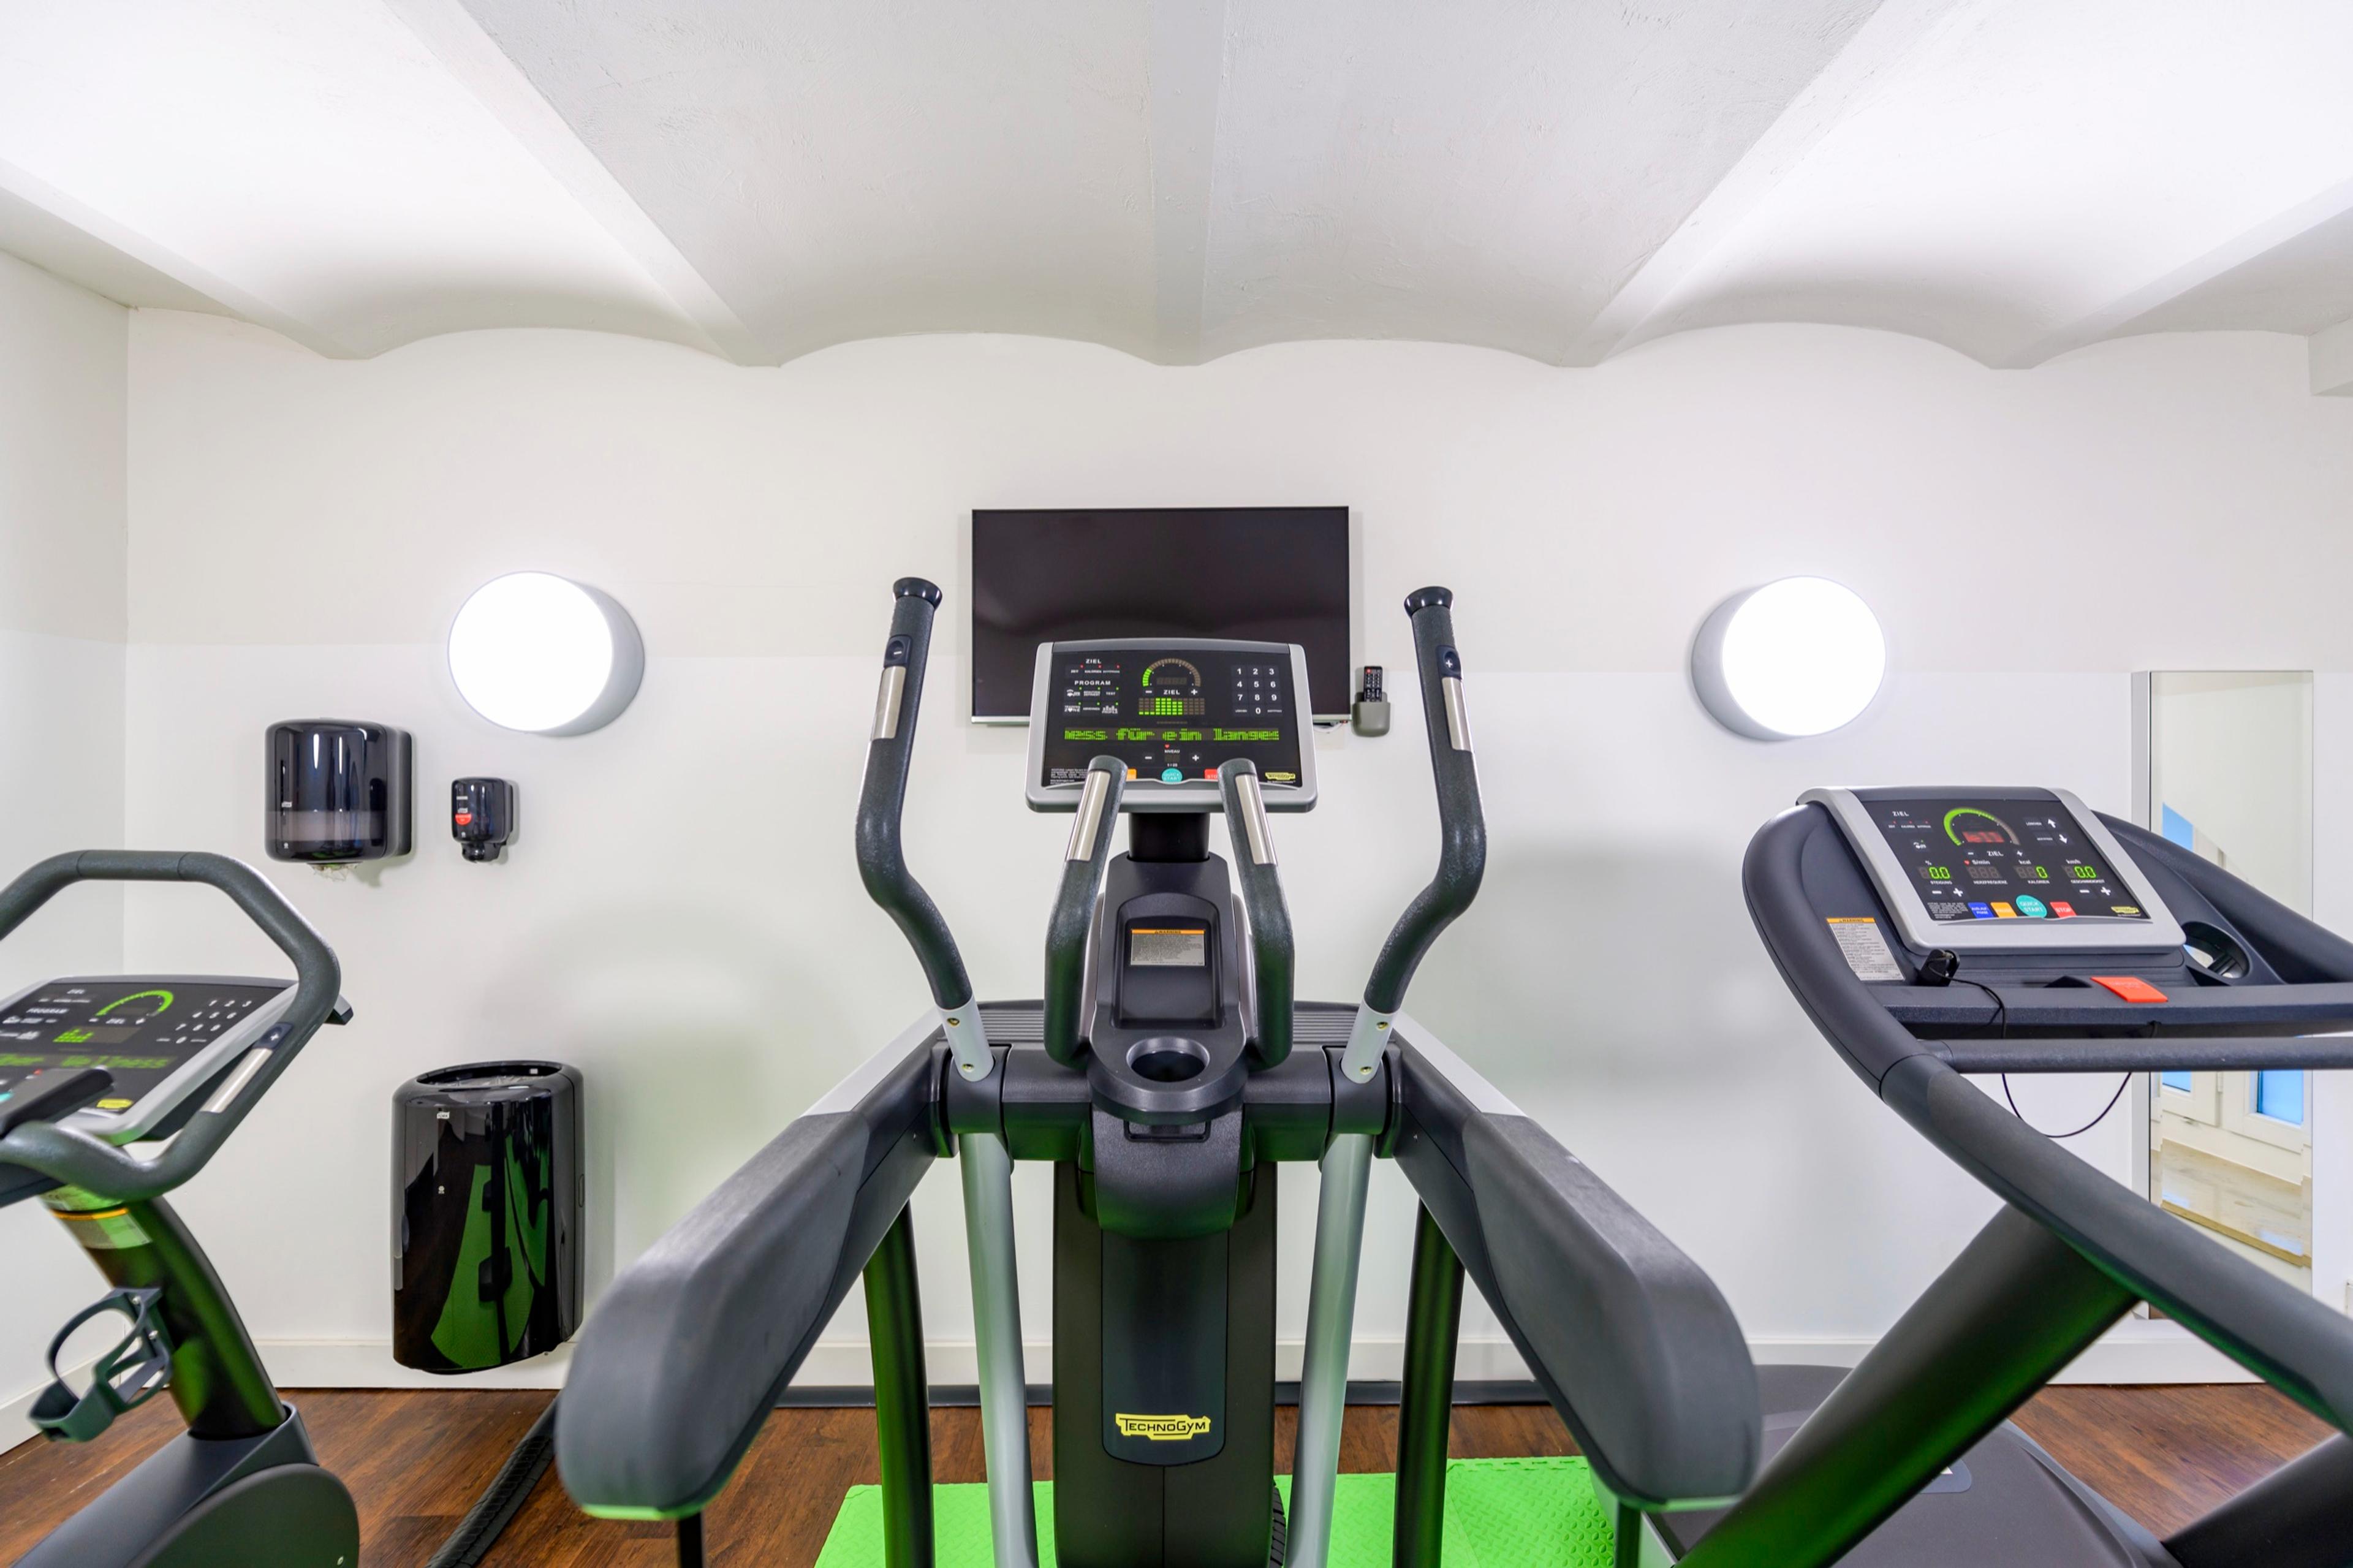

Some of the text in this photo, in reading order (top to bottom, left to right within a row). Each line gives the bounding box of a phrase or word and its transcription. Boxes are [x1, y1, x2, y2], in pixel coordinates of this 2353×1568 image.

[1163, 728, 1202, 740] ein
[1929, 866, 1950, 879] 0.0
[2036, 866, 2048, 879] 0
[2074, 866, 2096, 879] 0.0
